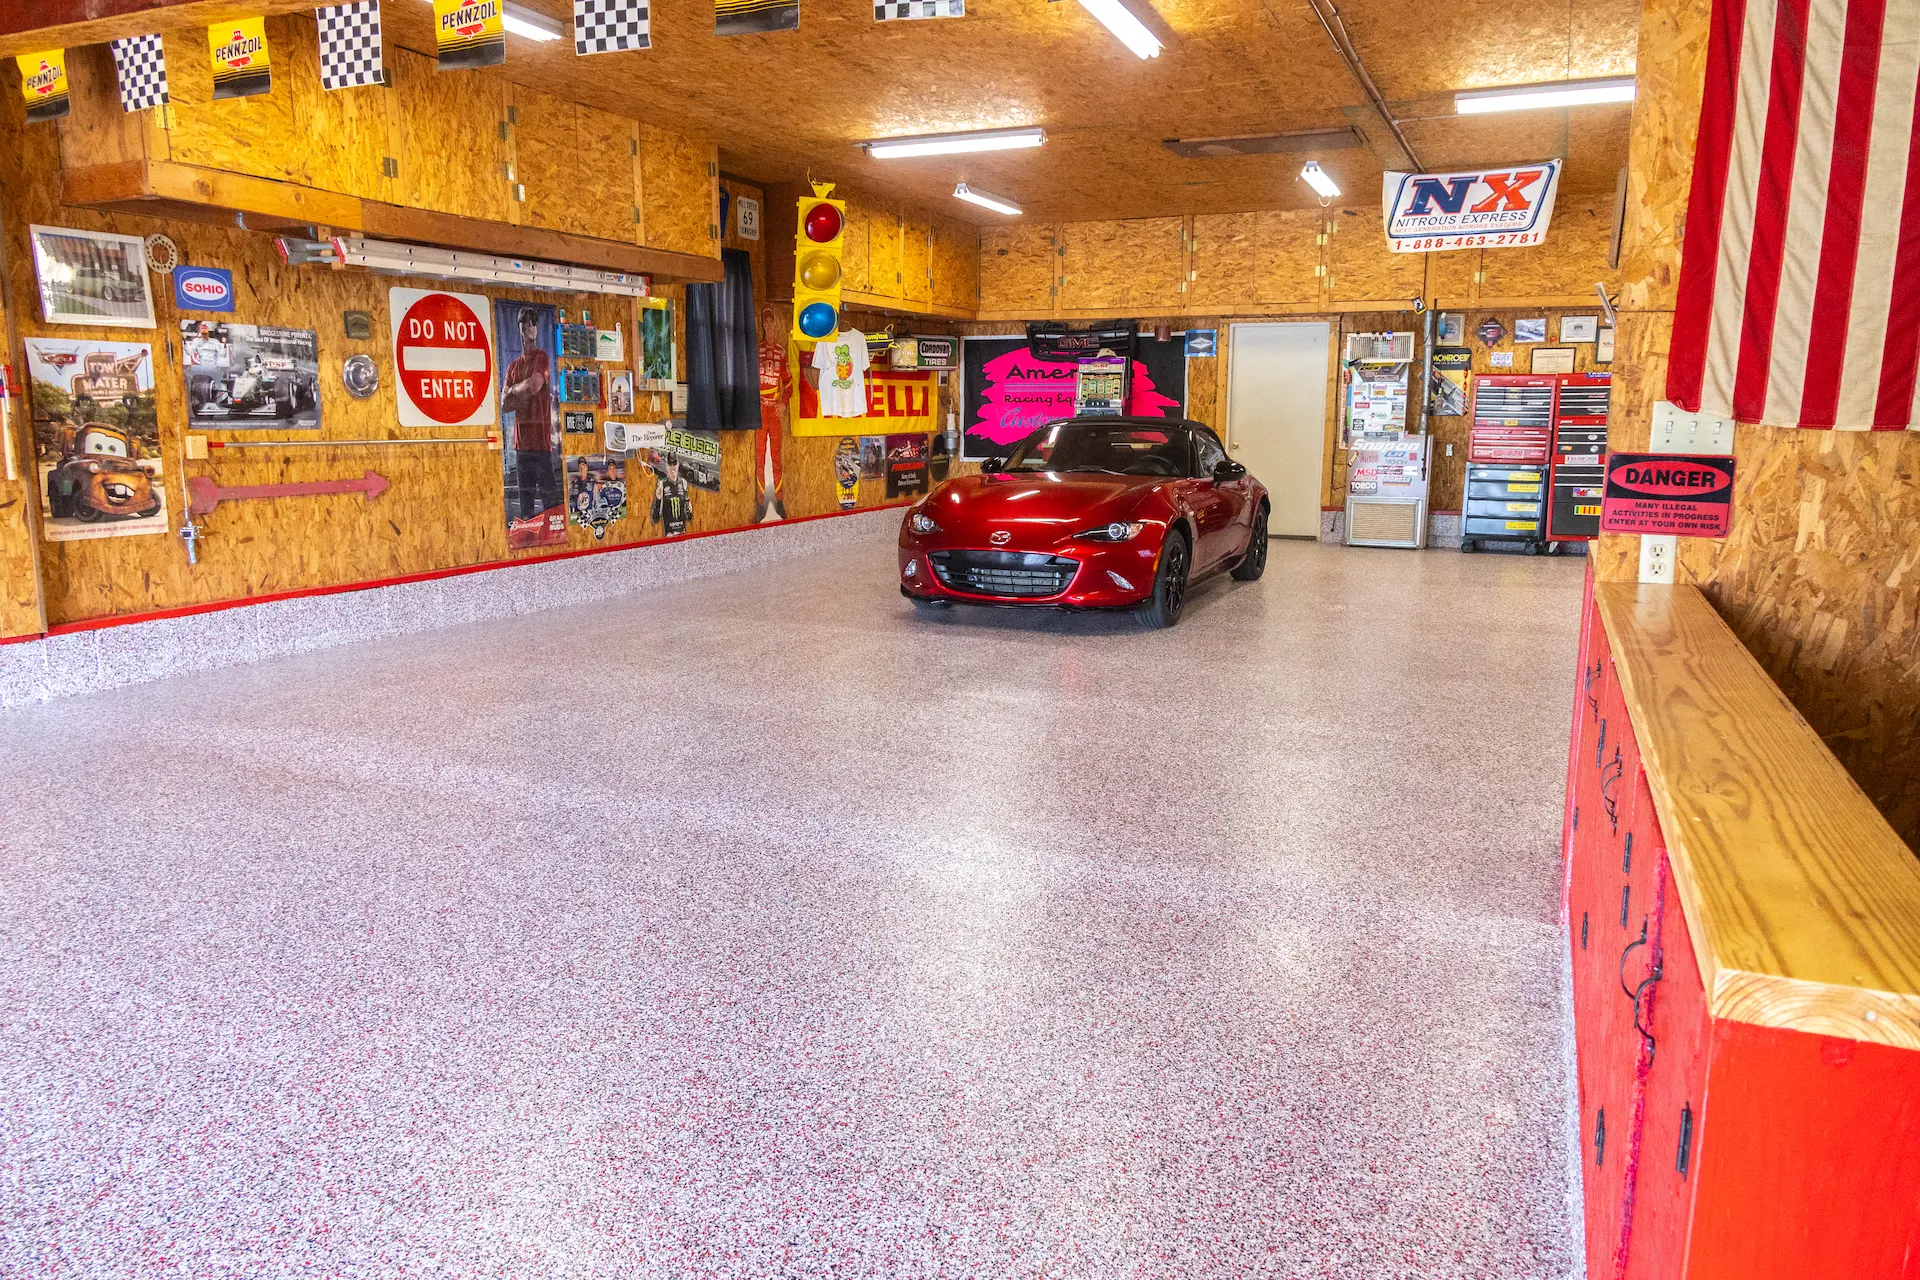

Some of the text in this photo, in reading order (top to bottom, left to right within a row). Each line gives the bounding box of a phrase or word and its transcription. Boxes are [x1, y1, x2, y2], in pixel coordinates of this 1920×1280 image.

[442, 1, 497, 30] PENNZOIL
[216, 36, 262, 63] PENNZOIL
[26, 65, 63, 90] PENNZOIL
[1402, 170, 1543, 217] NX
[743, 211, 753, 225] 69
[1396, 211, 1528, 228] NITROUS EXPRESS
[1395, 232, 1539, 250] 1-888-463-2781
[185, 282, 224, 295] SOHIO
[410, 318, 476, 341] DO NOT
[921, 342, 950, 354] CORDOVAN
[1058, 337, 1099, 348] GMC
[924, 358, 947, 366] TIRES
[1433, 354, 1468, 362] MONROE
[89, 362, 115, 375] TOW
[1005, 364, 1078, 379] Amer
[421, 378, 474, 398] ENTER
[1004, 393, 1076, 407] Racing Eq
[585, 416, 593, 429] 66
[643, 433, 664, 443] Reporter
[684, 434, 718, 457] BUSCH
[1350, 439, 1420, 452] Snap-on
[891, 462, 925, 472] FIREHAWK
[1356, 468, 1378, 476] MSD
[1625, 468, 1717, 488] DANGER
[1351, 481, 1377, 489] TORCO
[1662, 503, 1697, 511] ILLEGAL
[1612, 510, 1659, 518] ACTIVITIES
[1673, 512, 1719, 521] PROGRESS
[508, 520, 544, 530] Budweiser
[1608, 518, 1636, 526] ENTER
[1652, 520, 1676, 528] YOUR
[1678, 521, 1698, 529] OWN
[1700, 522, 1720, 530] RISK
